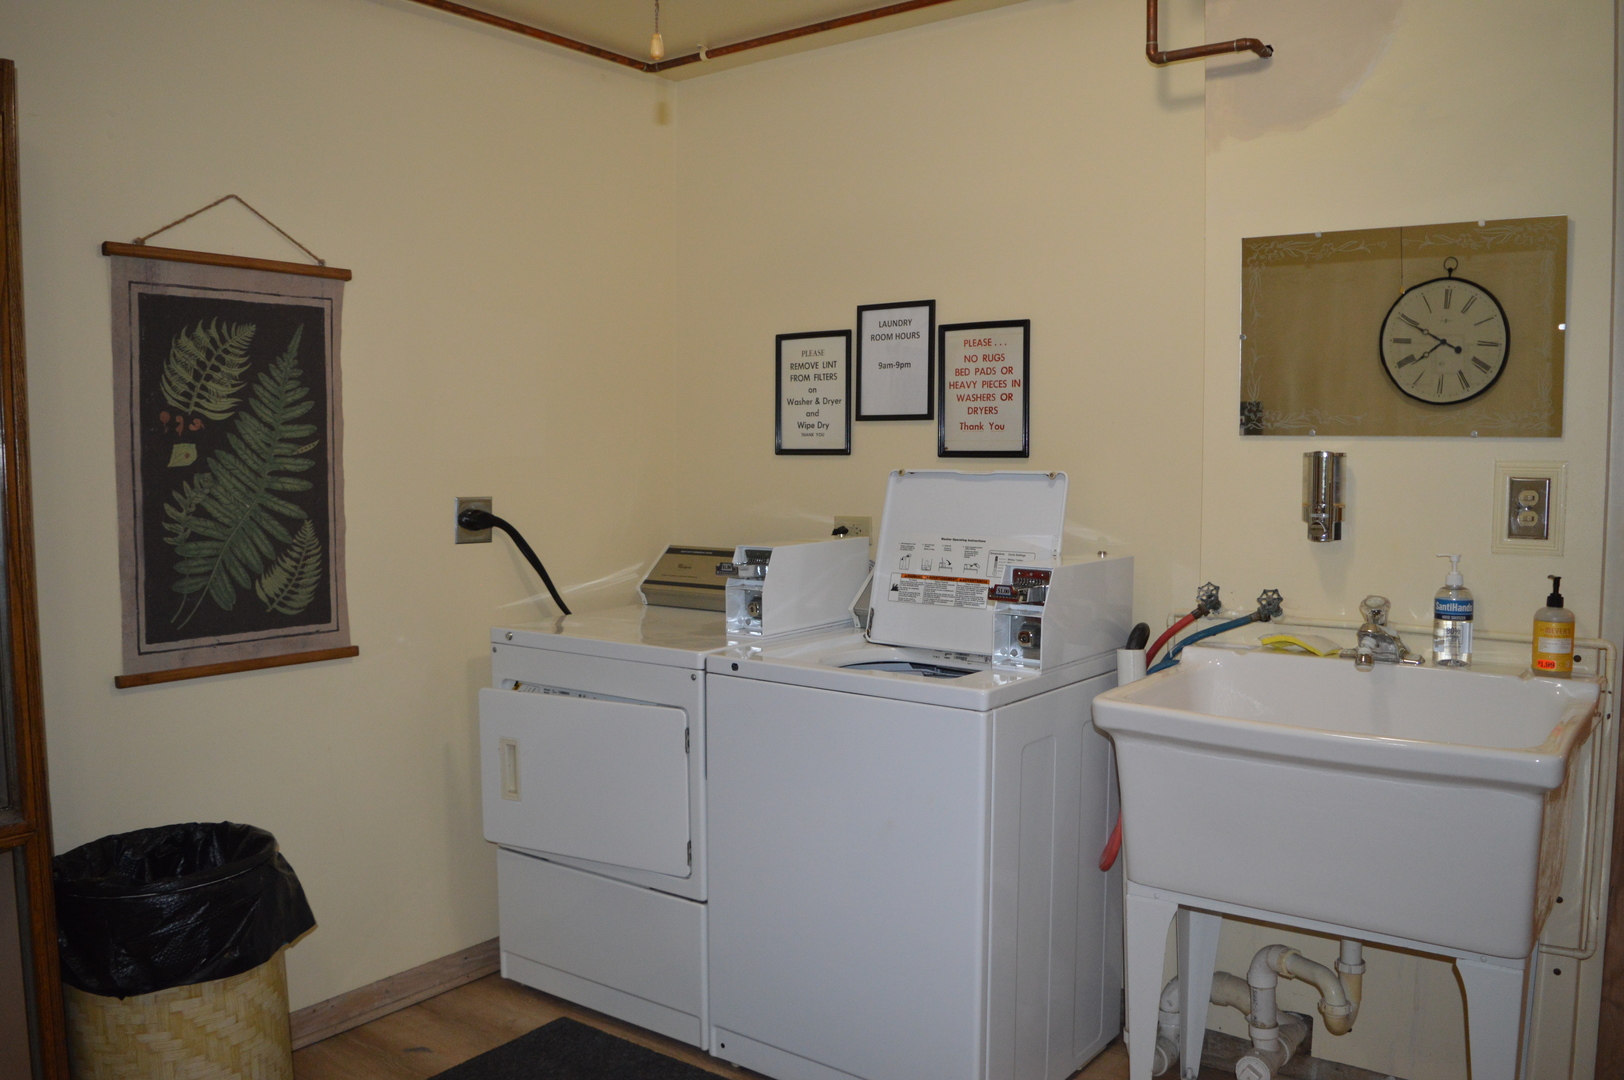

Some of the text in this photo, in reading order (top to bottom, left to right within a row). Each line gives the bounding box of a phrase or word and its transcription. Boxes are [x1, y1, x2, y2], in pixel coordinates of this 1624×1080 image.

[879, 318, 912, 328] LAUNDRY
[870, 332, 920, 342] ROOM HOURS
[964, 338, 992, 347] PLEASE
[801, 349, 824, 357] PLEASE
[964, 353, 1006, 363] NO RUGS
[790, 360, 838, 370] REMOVE LINT
[878, 361, 911, 370] 9am-9pm
[954, 366, 1014, 376] BED PADS OR
[790, 372, 838, 382] FROM FILTERS
[948, 379, 1021, 390] HEAVY PIECES IN
[786, 398, 812, 406] Washer
[822, 397, 842, 406] Dryer
[956, 392, 1013, 402] WASHERS OR
[806, 409, 819, 417] and
[968, 406, 998, 415] DRYERS
[797, 421, 830, 430] Wipe Dry
[960, 422, 1005, 430] Thank You
